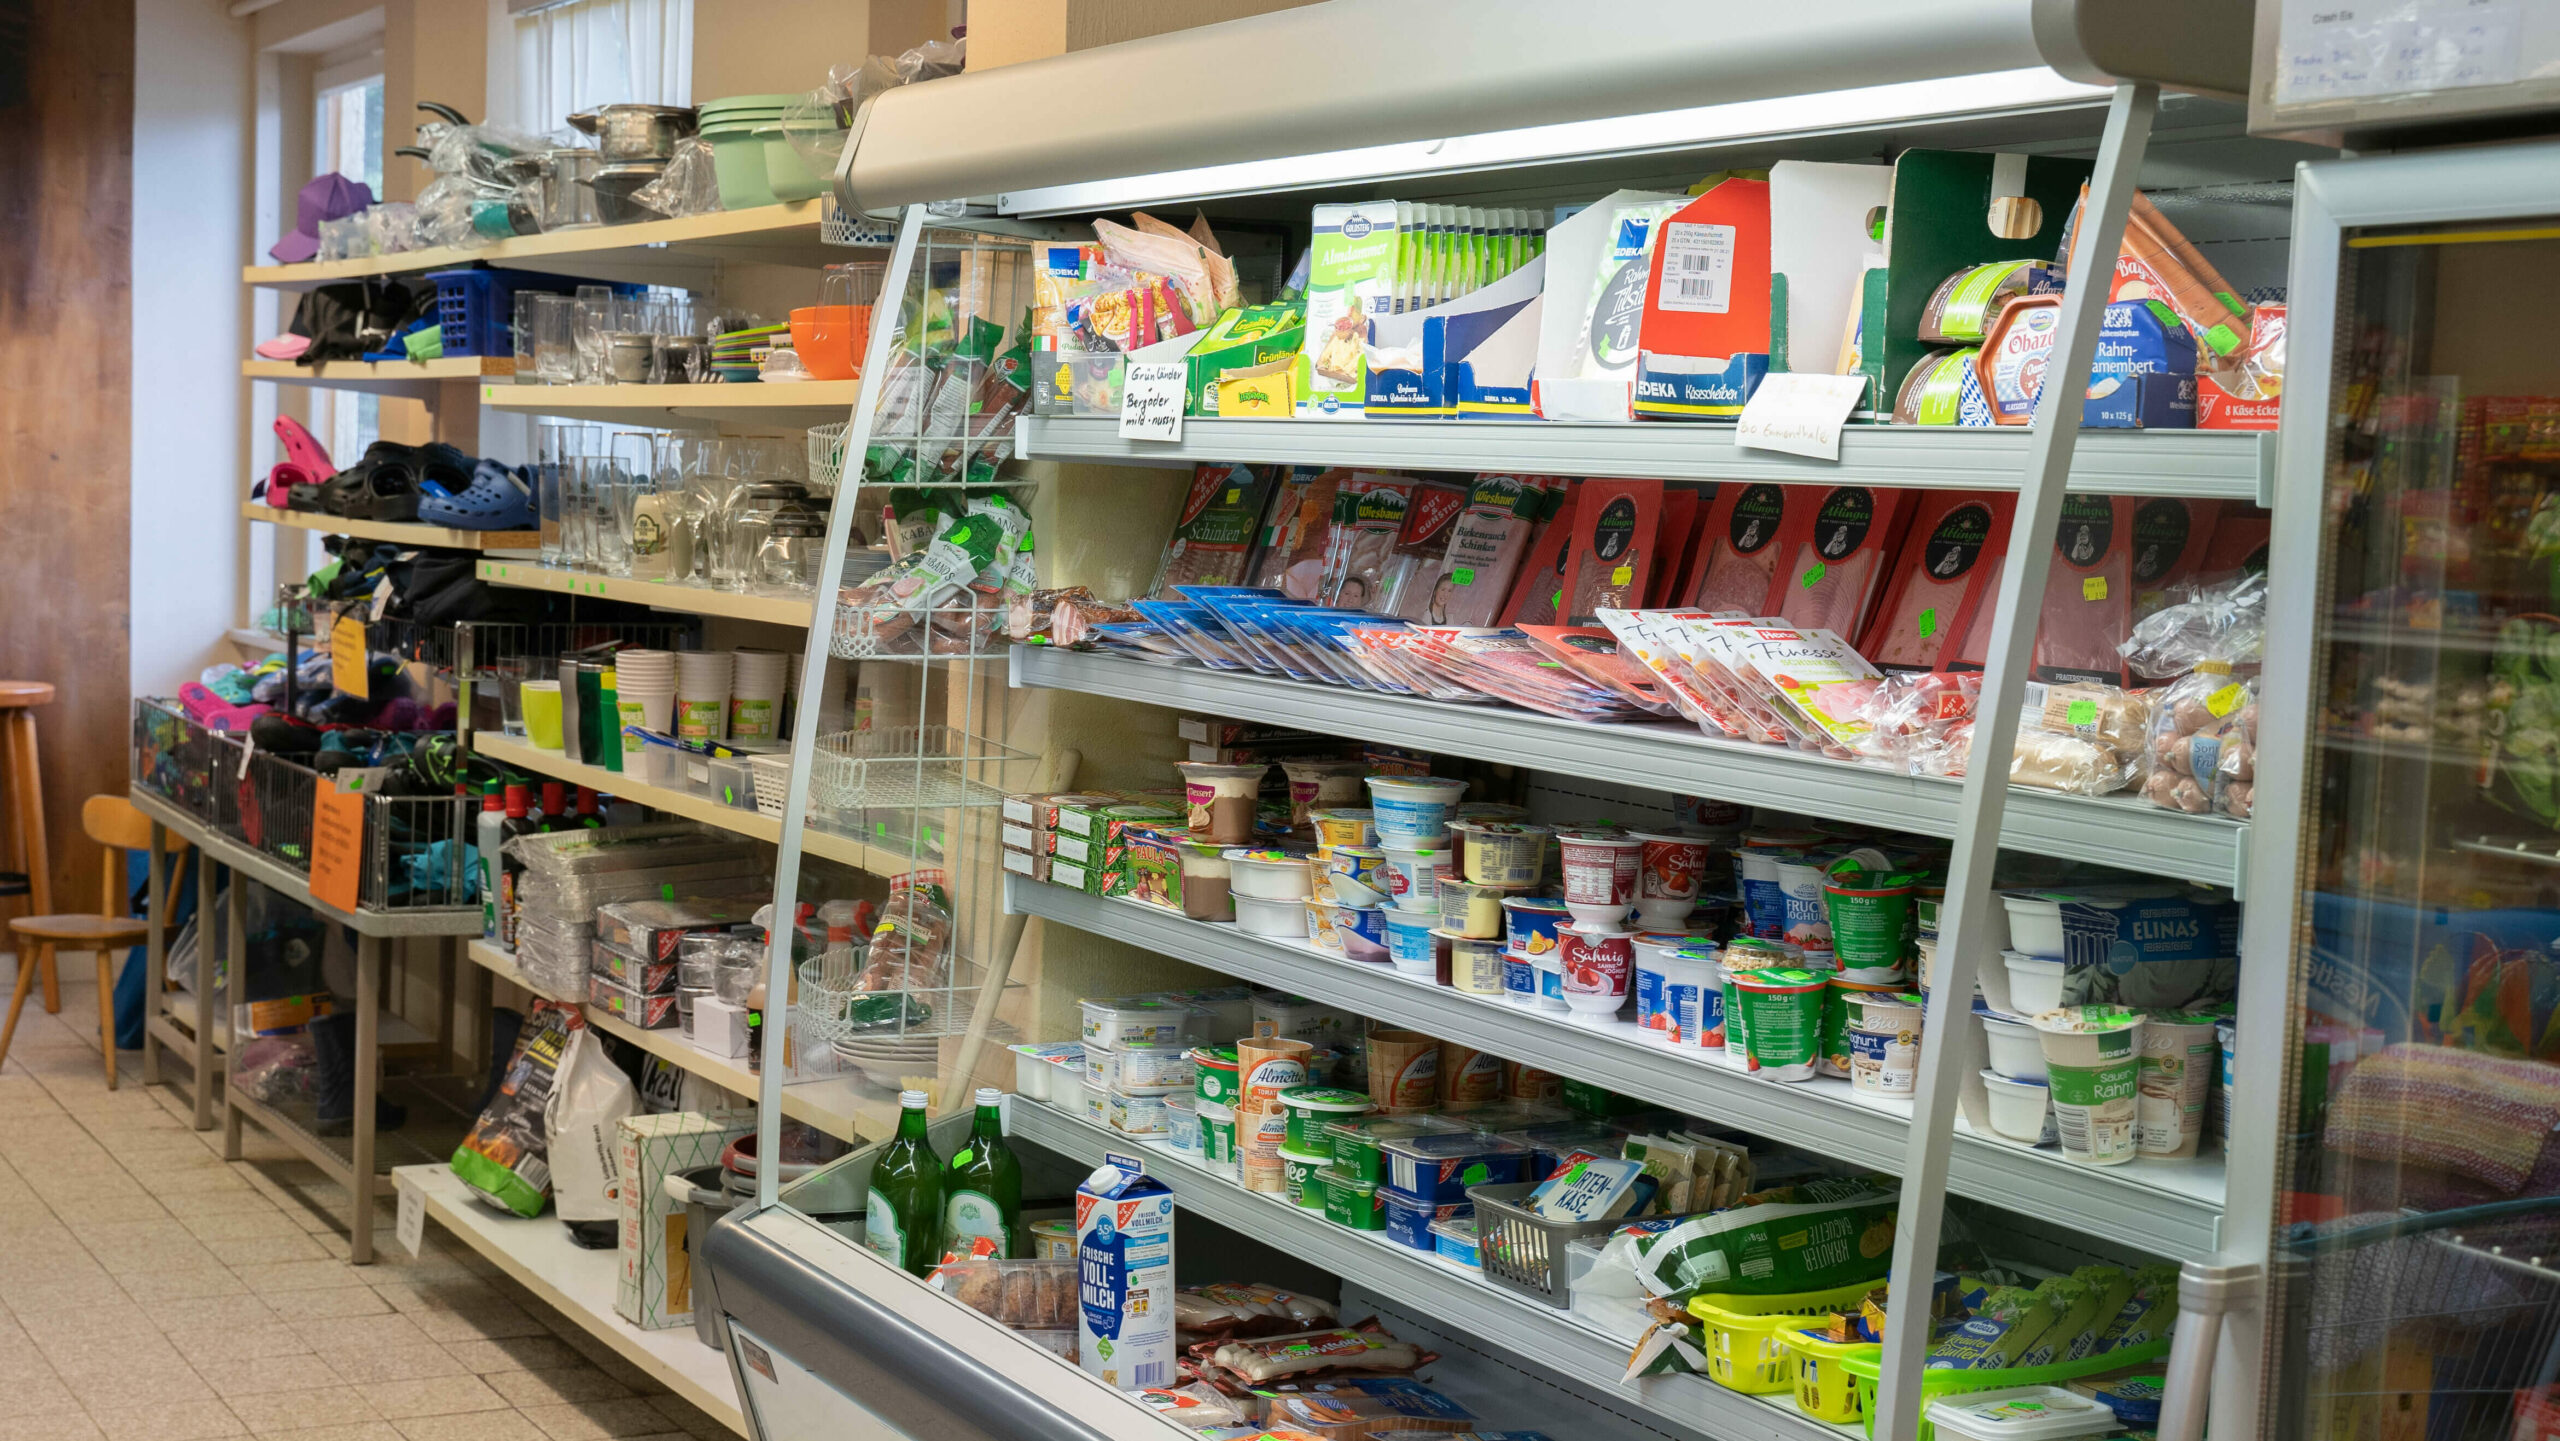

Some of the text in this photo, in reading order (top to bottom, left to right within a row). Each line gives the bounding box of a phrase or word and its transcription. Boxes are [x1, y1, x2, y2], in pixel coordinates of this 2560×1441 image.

[1345, 223, 1370, 232] GOLDSTEIG
[1321, 243, 1388, 267] Almdammer
[1615, 247, 1643, 257] EDEKA
[1049, 268, 1079, 277] EDEKA
[2098, 342, 2137, 357] Rahm-
[2091, 359, 2154, 375] amembert
[1638, 383, 1738, 400] EDEKA Käsescheiben
[2102, 411, 2109, 420] 10
[2116, 411, 2126, 420] 125
[1421, 495, 1440, 513] GUT
[1475, 490, 1517, 506] Wiesbauer
[1189, 523, 1240, 543] Schinken
[1457, 526, 1506, 541] Birkenrauch
[1459, 539, 1496, 552] Schinken
[1747, 641, 1844, 661] Finesse
[1189, 787, 1214, 798] Dessert
[1293, 785, 1318, 796] Dessert
[1136, 846, 1165, 867] PAULA
[1851, 897, 1869, 906] 150 g
[2132, 920, 2199, 942] ELINAS
[1572, 948, 1624, 965] Sahnig
[1768, 994, 1788, 1003] 150 g
[1866, 1010, 1898, 1030] Bio
[1252, 1066, 1304, 1084] Almette
[2100, 1069, 2133, 1084] Sauer-
[2094, 1081, 2134, 1099] Rahm
[1565, 1170, 1612, 1196] IRTEN-
[1554, 1188, 1594, 1215] KÄSE
[1131, 1216, 1163, 1227] VOLLMILCH
[1808, 1216, 1853, 1244] BAGUETTE
[1083, 1246, 1115, 1266] FRISCHE
[1802, 1240, 1850, 1272] KRÄUTER
[1083, 1259, 1115, 1288] VOLL-
[1082, 1283, 1115, 1310] MILCH
[1969, 1321, 1998, 1334] MEGGLE
[1935, 1344, 1979, 1361] Butter
